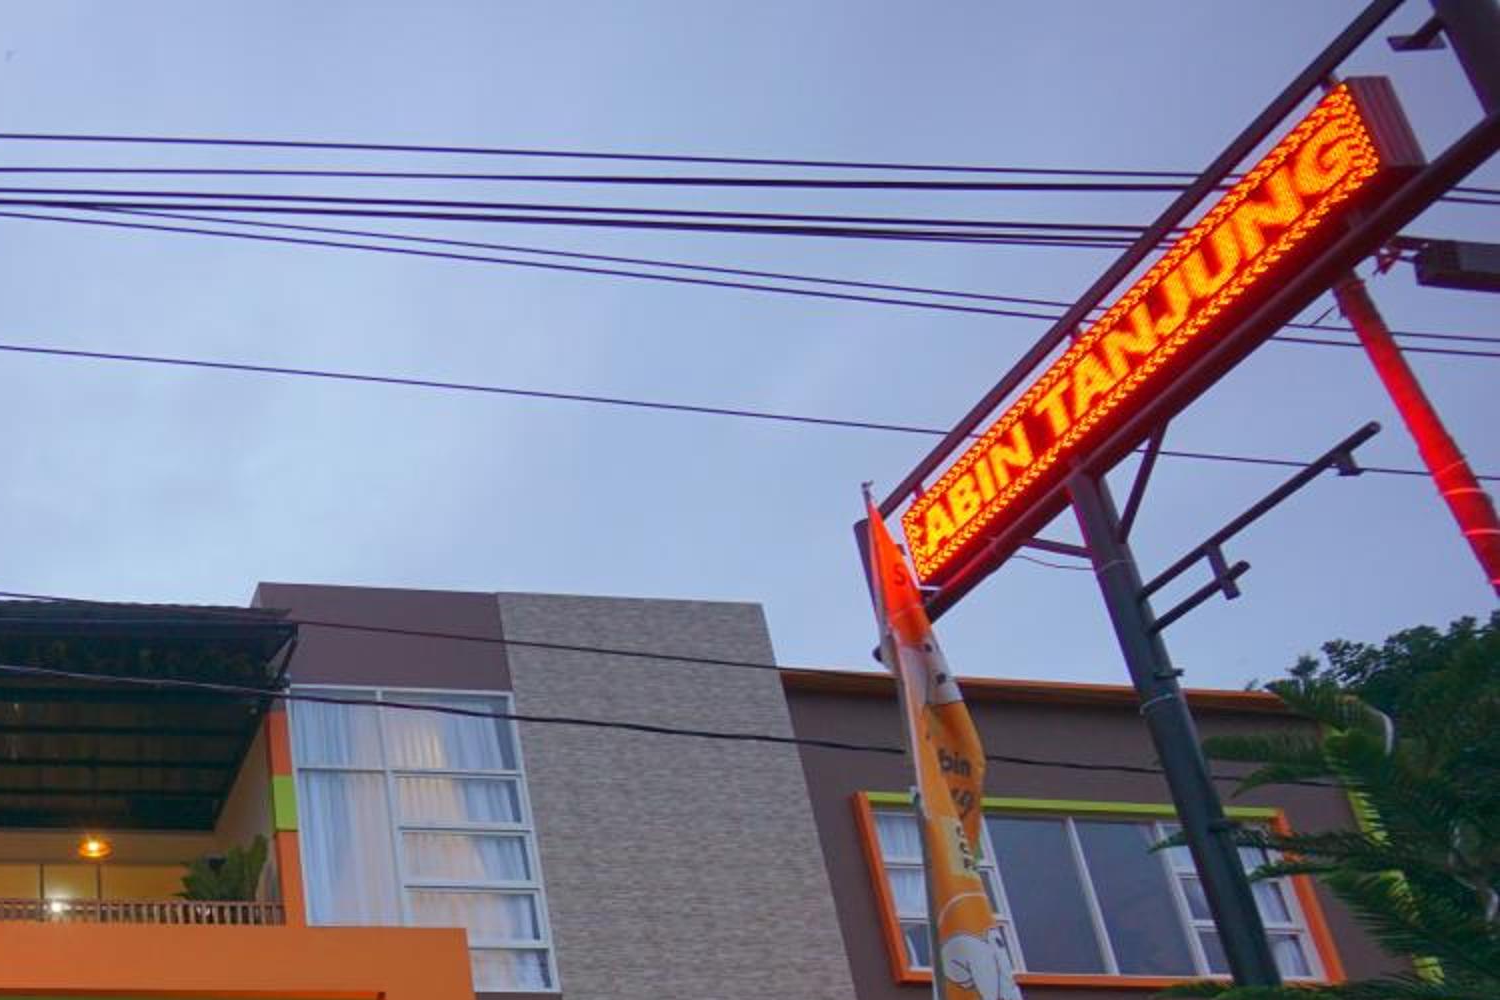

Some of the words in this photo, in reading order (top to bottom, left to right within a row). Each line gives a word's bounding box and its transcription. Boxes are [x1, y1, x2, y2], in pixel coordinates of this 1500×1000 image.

[925, 421, 1034, 555] ABIN
[1034, 118, 1354, 438] TANJUNG
[937, 747, 972, 777] bin
